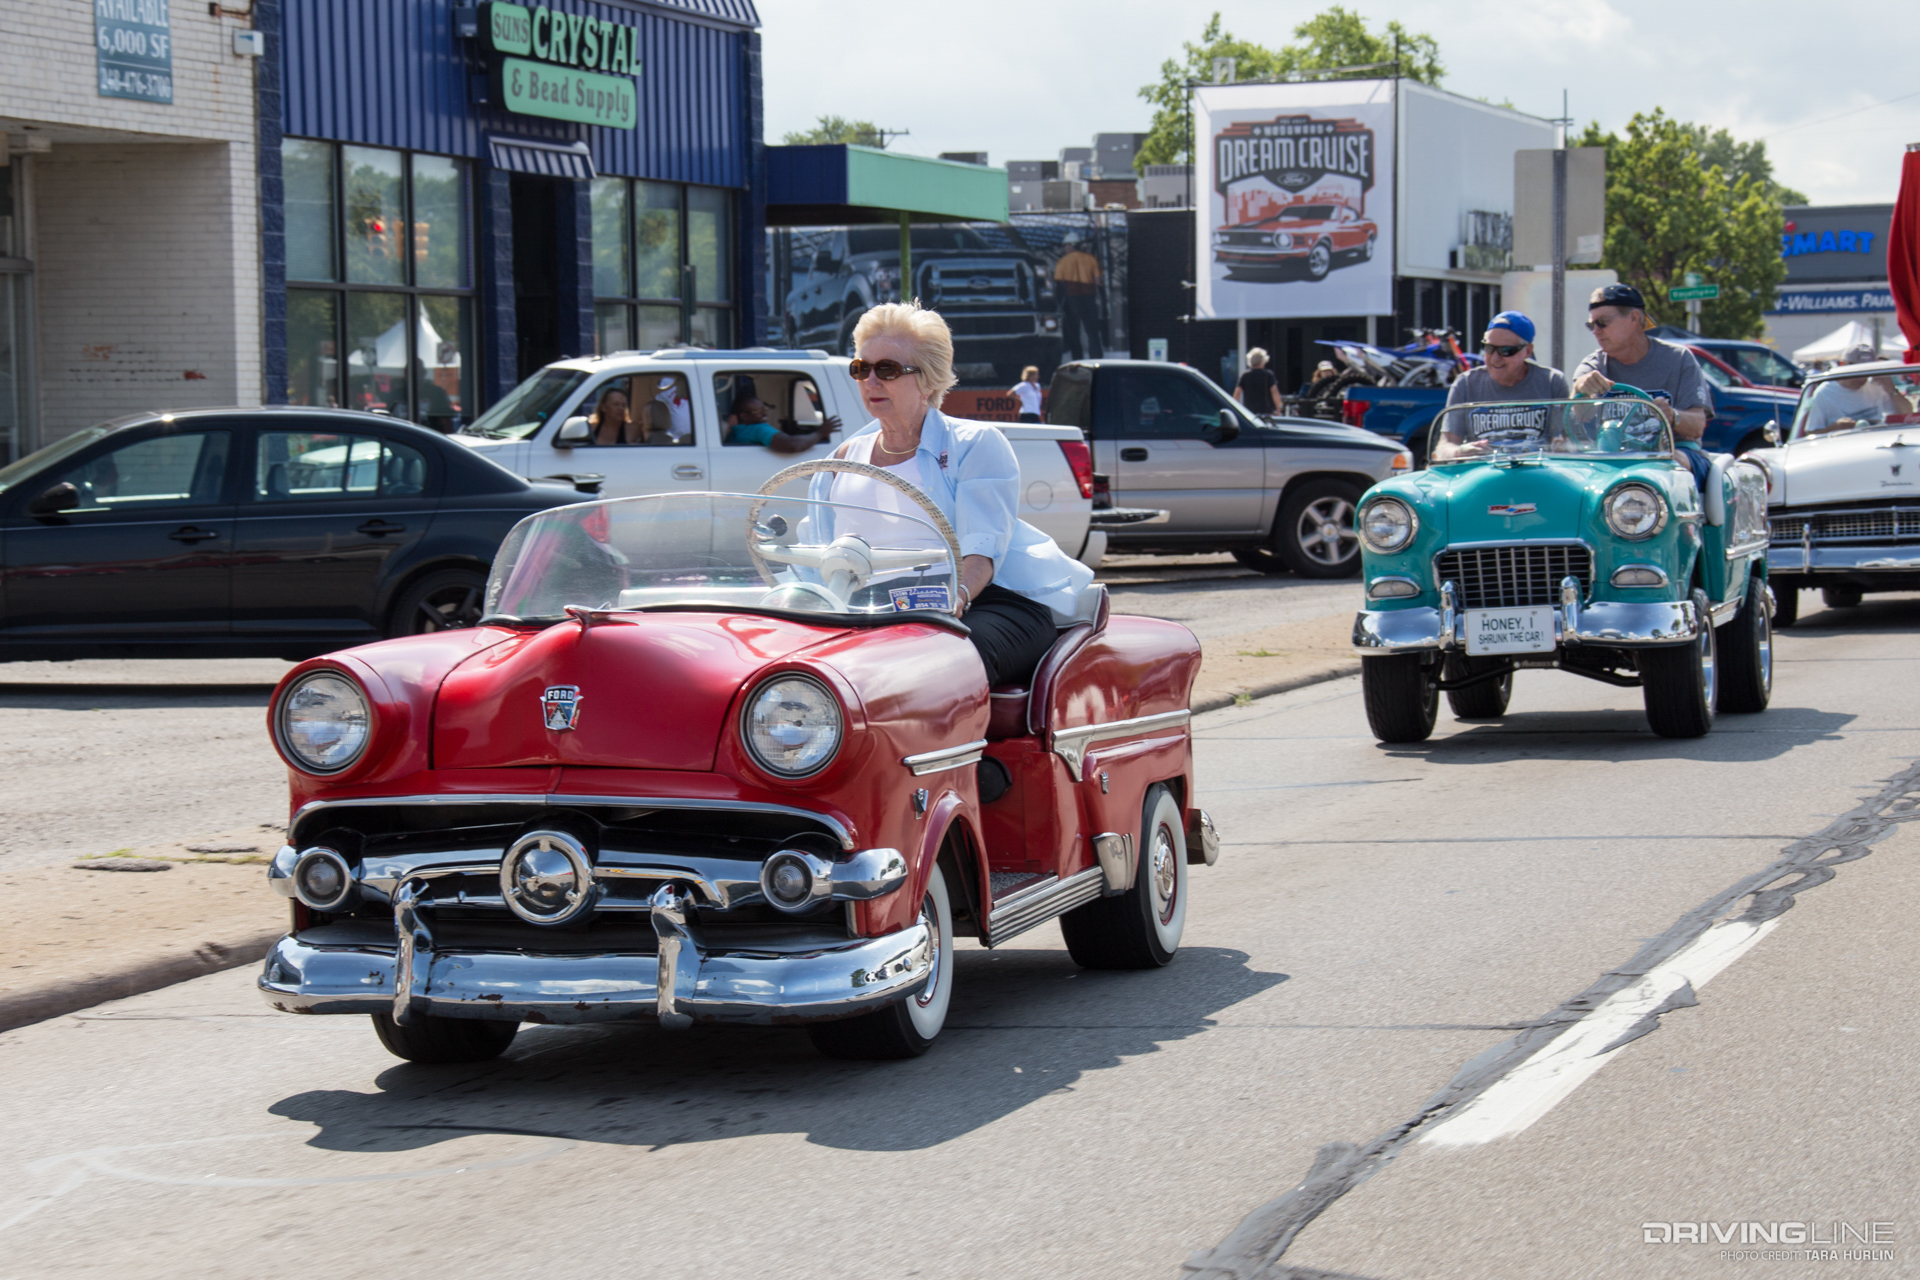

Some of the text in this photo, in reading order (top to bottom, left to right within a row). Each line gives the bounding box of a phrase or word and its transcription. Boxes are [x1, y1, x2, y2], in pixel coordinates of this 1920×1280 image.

[98, 26, 169, 58] 6,000 SF
[494, 5, 642, 76] SUNS CRYSTAL
[511, 68, 630, 122] & Bead Supply
[1219, 135, 1369, 183] DREAM CRUISE
[976, 397, 1015, 412] FORD
[1472, 413, 1510, 435] DREAM
[1482, 617, 1534, 631] HONEY, I
[1478, 632, 1508, 645] SHRUNK
[1509, 631, 1523, 642] THE
[547, 690, 575, 700] FORD
